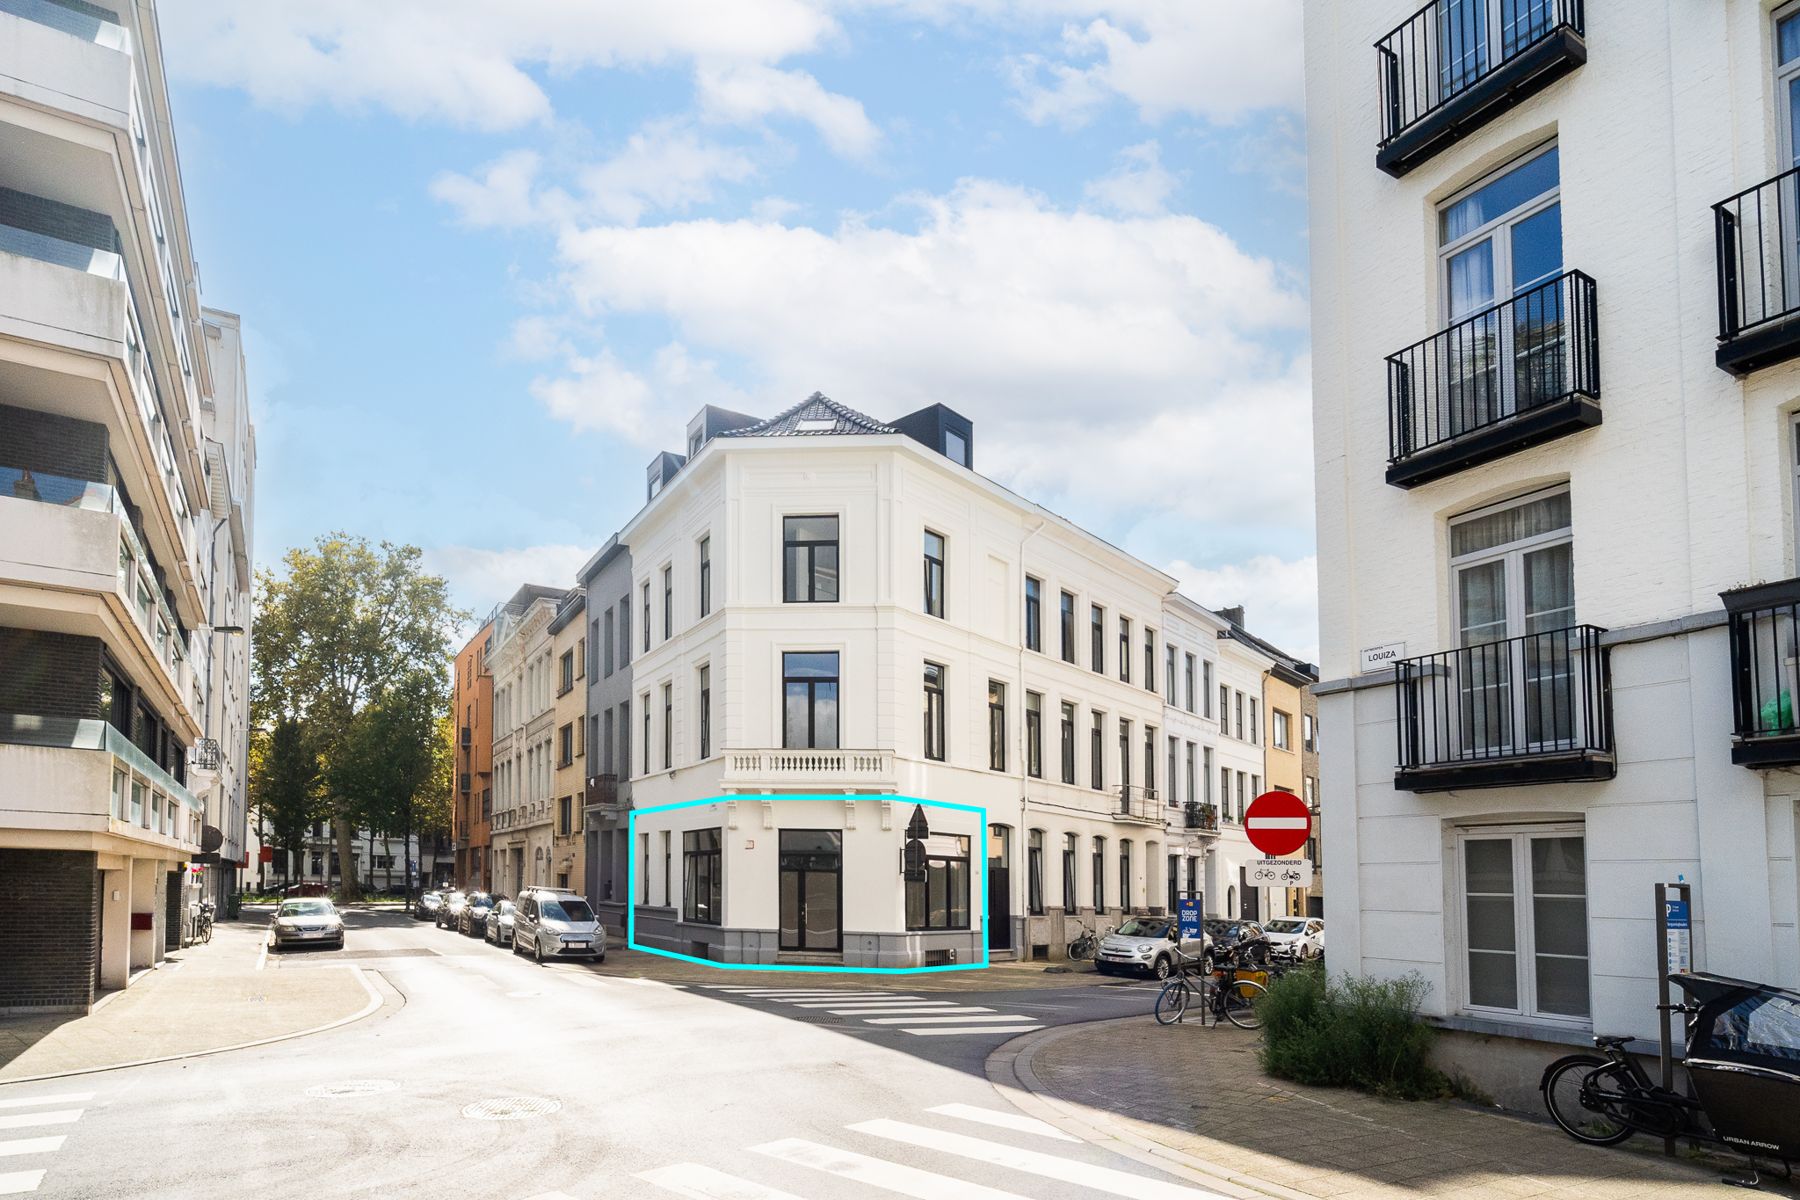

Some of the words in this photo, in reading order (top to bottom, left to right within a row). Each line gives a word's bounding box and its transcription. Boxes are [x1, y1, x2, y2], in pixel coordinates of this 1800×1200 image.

[1368, 650, 1396, 662] LOUIZA
[1666, 904, 1671, 917] P
[1723, 1136, 1750, 1145] URBAN
[1751, 1141, 1779, 1150] ARROW
